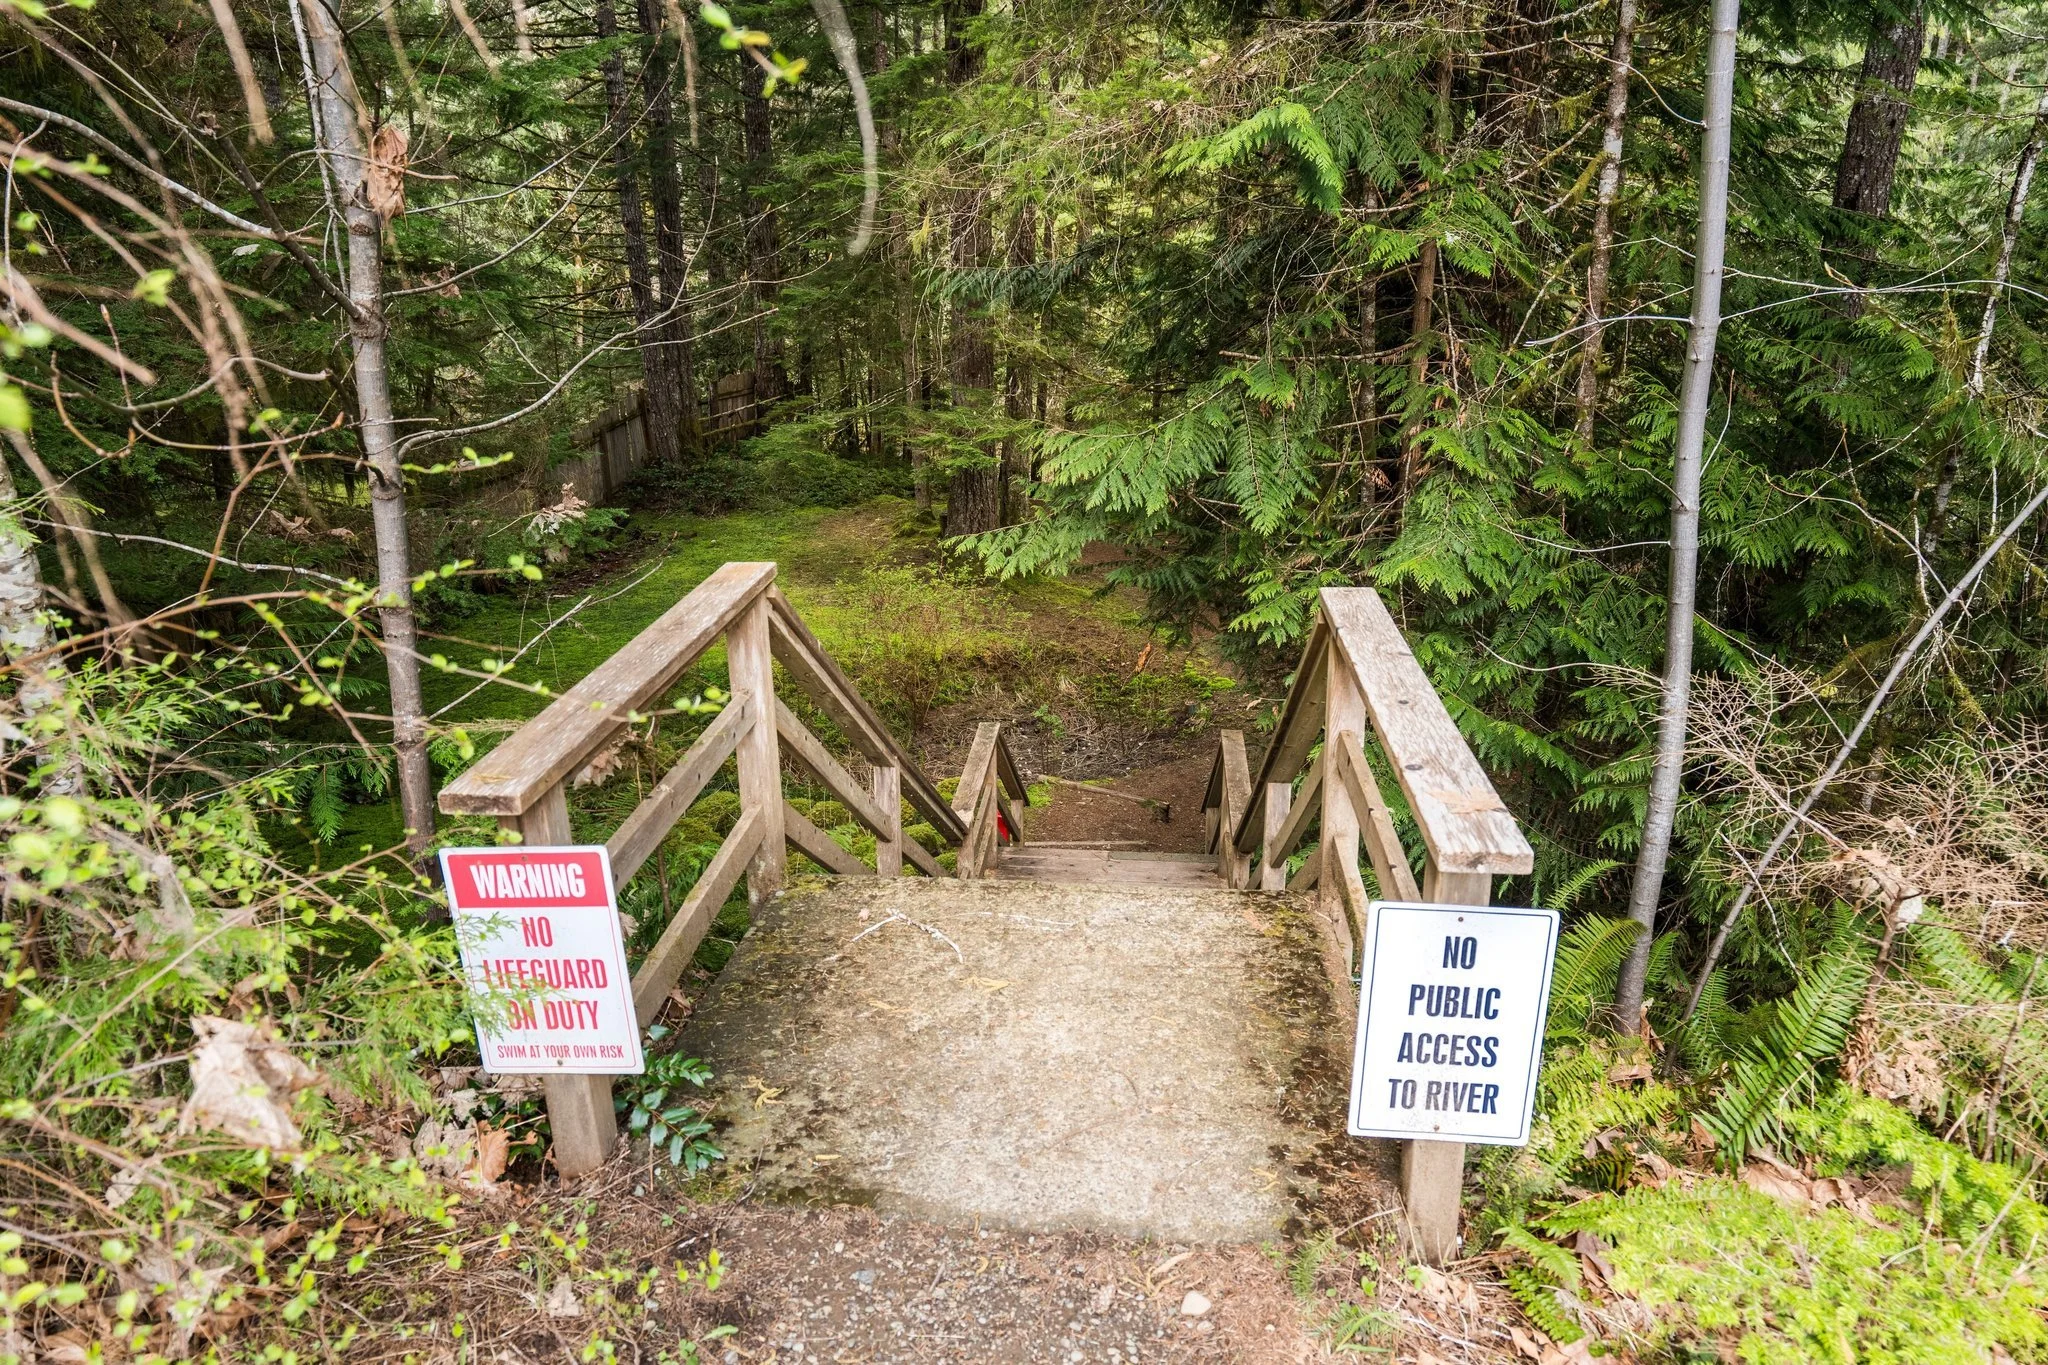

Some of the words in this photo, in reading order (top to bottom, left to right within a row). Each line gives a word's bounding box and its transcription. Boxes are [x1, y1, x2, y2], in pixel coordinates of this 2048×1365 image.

[469, 862, 587, 900] WARNING
[521, 916, 554, 948] NO
[1442, 935, 1478, 970] NO
[482, 958, 609, 990] LIFEGUARD
[543, 1000, 599, 1031] DUTY
[1407, 983, 1502, 1021] PUBLIC
[497, 1045, 529, 1059] SWIM
[529, 1045, 541, 1059] AT
[543, 1045, 572, 1059] YOUR
[573, 1045, 597, 1059] OWN
[599, 1045, 625, 1059] RISK
[1396, 1031, 1500, 1068] ACCESS
[1387, 1077, 1418, 1110] TO
[1425, 1079, 1500, 1115] RIVER
